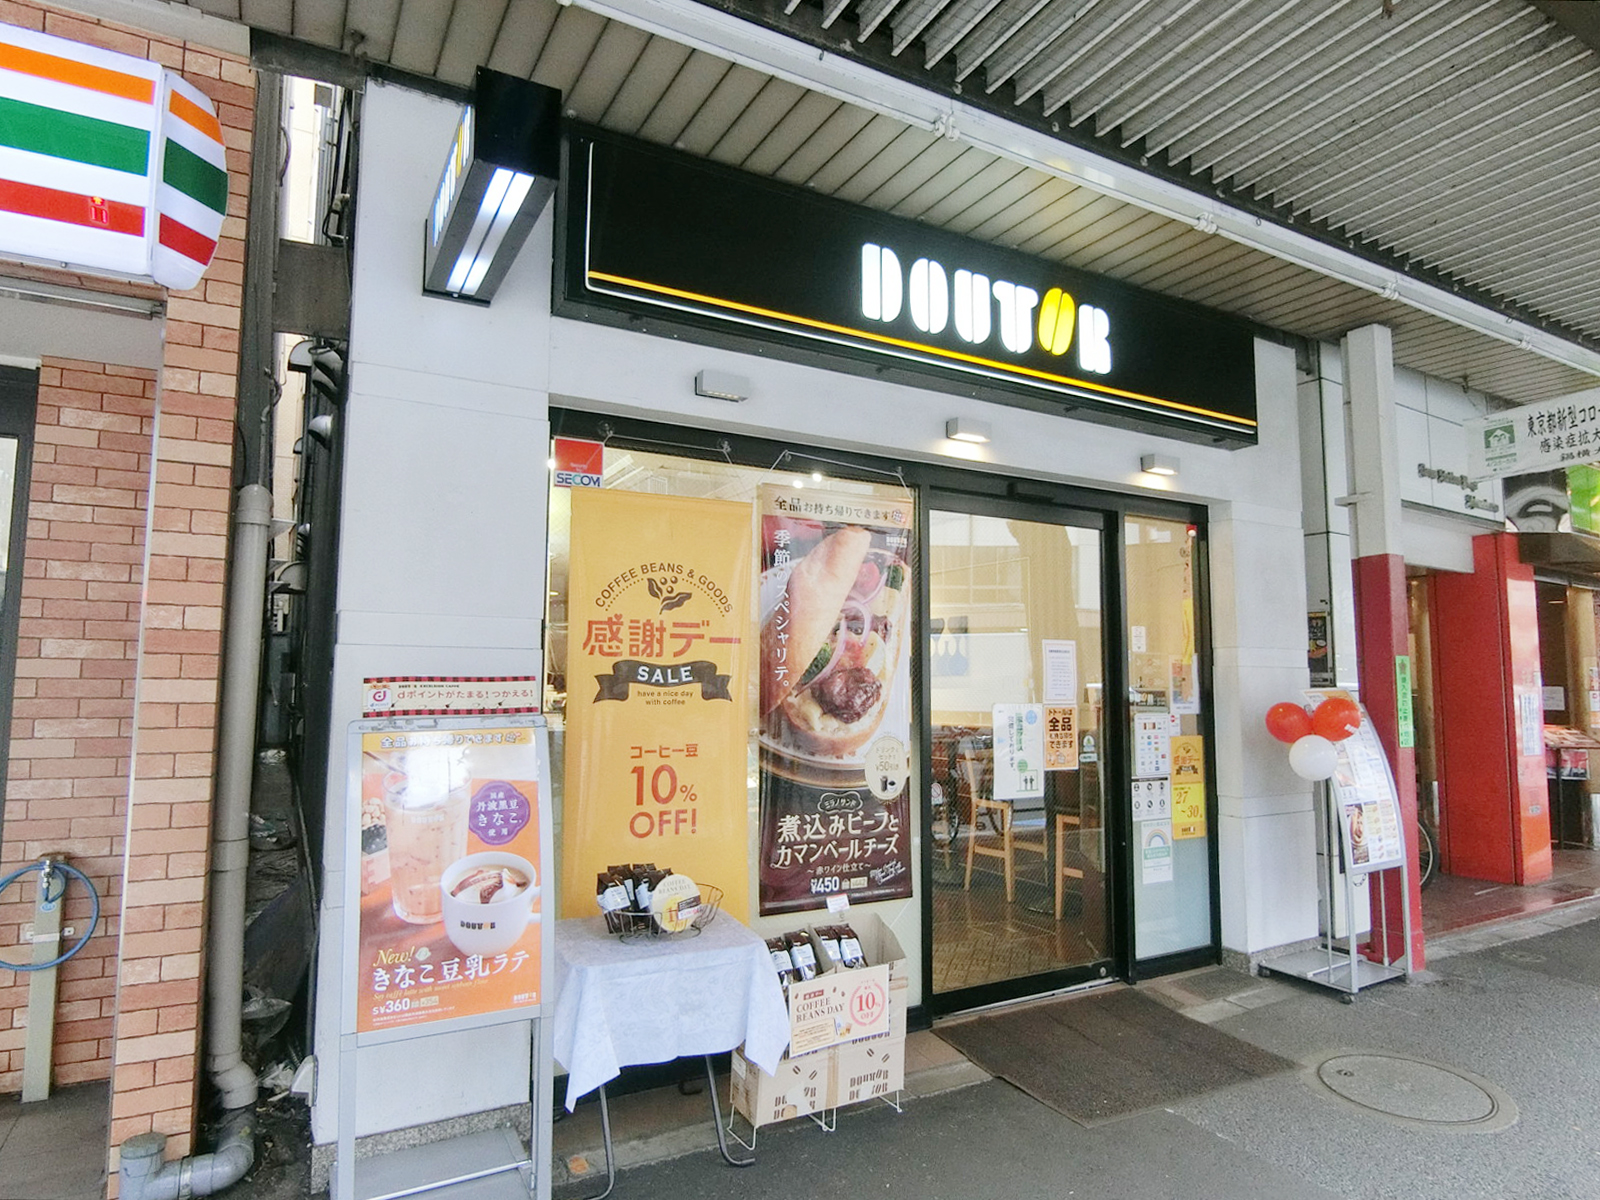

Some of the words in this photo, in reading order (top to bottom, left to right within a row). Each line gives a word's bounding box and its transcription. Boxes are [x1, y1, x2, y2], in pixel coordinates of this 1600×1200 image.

[861, 242, 1112, 375] DOUTOR
[1527, 404, 1600, 438] 東京都新型コロ
[556, 472, 601, 488] SECOM
[595, 567, 638, 608] COFFEE
[640, 562, 684, 575] BEANS
[686, 569, 696, 579] &
[698, 575, 734, 613] GOODS
[582, 613, 742, 658] 感謝デー
[636, 665, 694, 683] SALE
[680, 690, 694, 698] day
[1048, 716, 1072, 732] 全品
[630, 743, 699, 759] コーヒー豆
[1049, 740, 1074, 749] できます
[630, 764, 698, 806] 10%
[1175, 790, 1188, 805] 27
[629, 808, 697, 839] OFF!
[776, 811, 900, 843] 煮込みビーフと
[772, 834, 900, 868] カマンベールチーズ
[810, 876, 840, 894] ¥450
[372, 945, 416, 967] New!
[373, 950, 530, 992] きなこ豆乳ラテ
[795, 1007, 826, 1023] BEANS
[826, 1003, 845, 1015] DAY
[796, 997, 832, 1014] COFFEE
